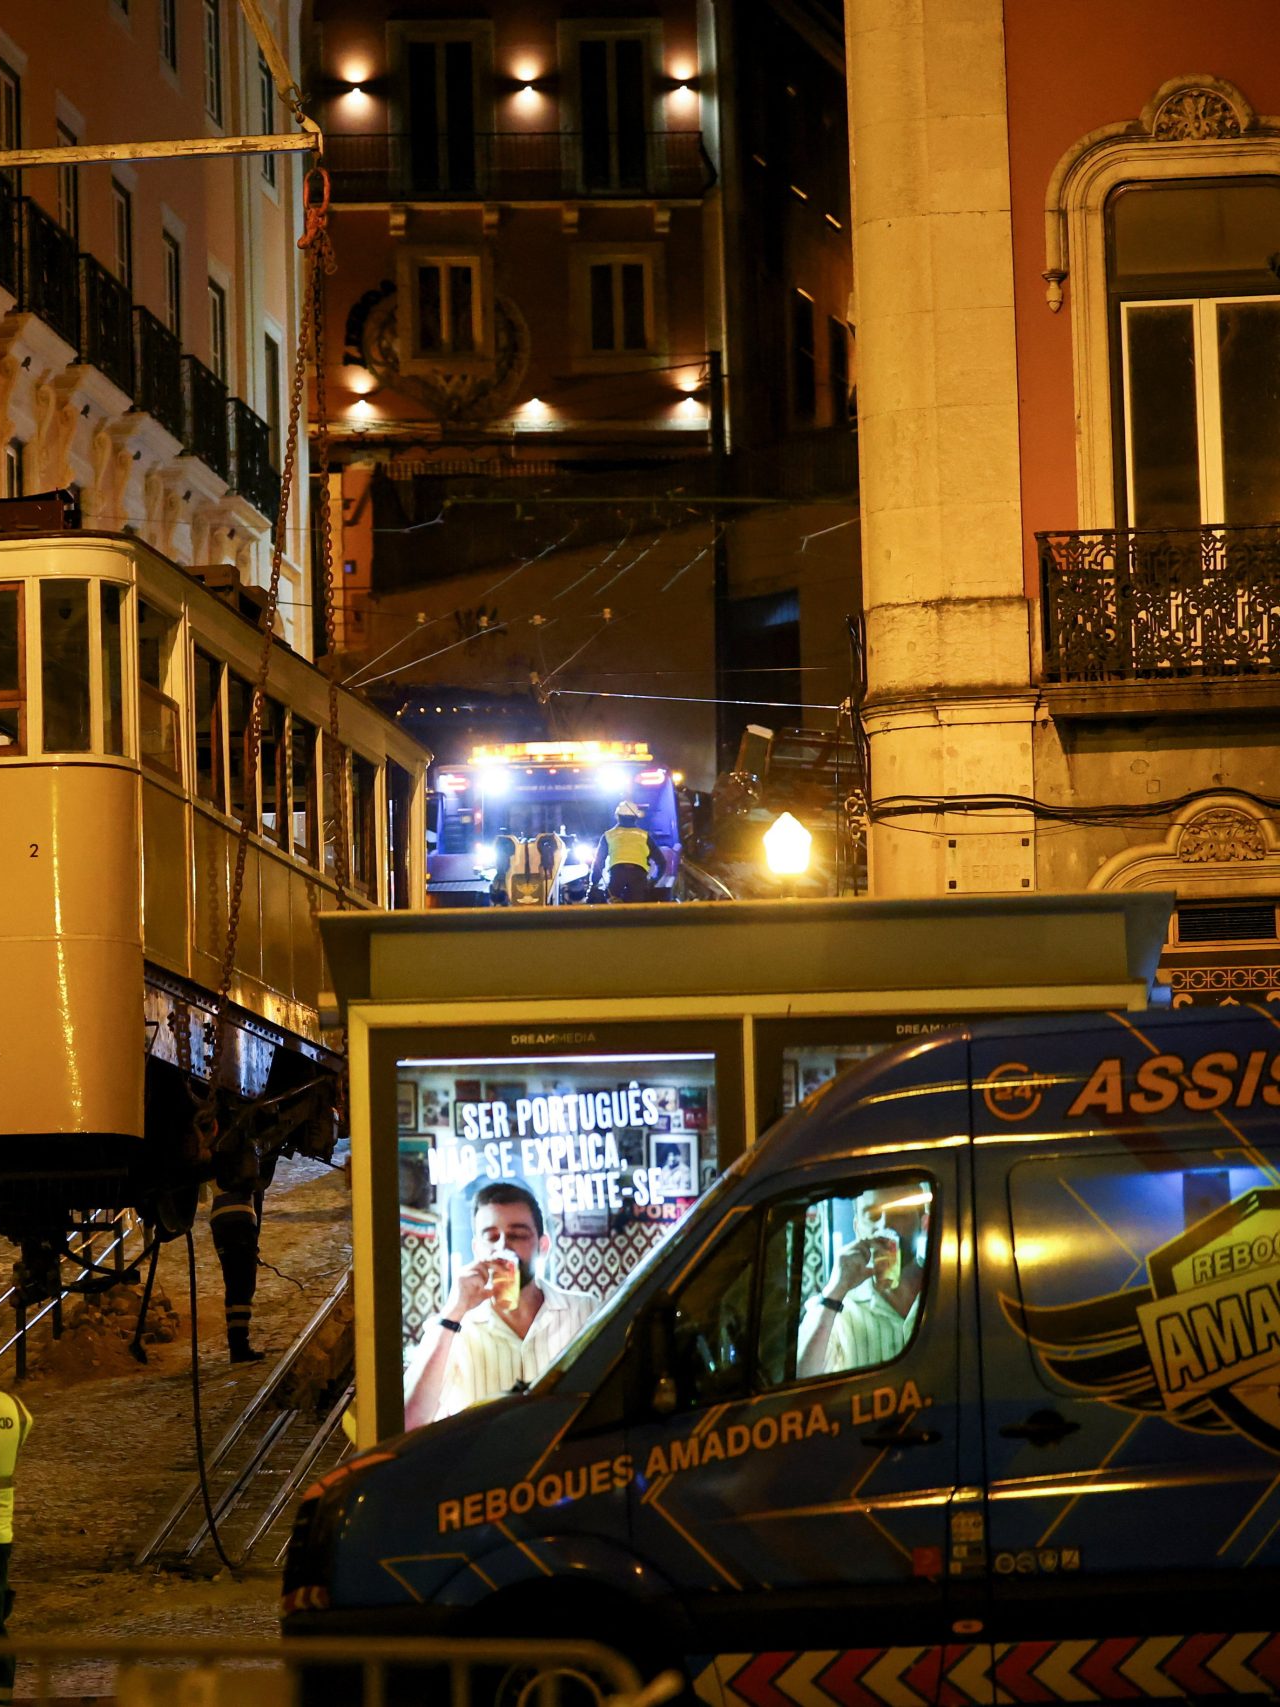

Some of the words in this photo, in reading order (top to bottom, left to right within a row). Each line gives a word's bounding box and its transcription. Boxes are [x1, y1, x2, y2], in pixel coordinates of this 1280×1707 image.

[29, 843, 39, 858] 2
[461, 1100, 510, 1141] SER
[516, 1080, 659, 1136] PORTUGUÊS
[483, 1141, 516, 1181] SE
[520, 1132, 628, 1176] EXPLICA,
[545, 1167, 665, 1215] SENTE-SE
[1193, 1232, 1280, 1284] REBO
[1157, 1281, 1280, 1393] AMA
[437, 1453, 634, 1534] REBOQUES
[643, 1404, 841, 1479] AMADORA,
[850, 1380, 934, 1425] LDA.
